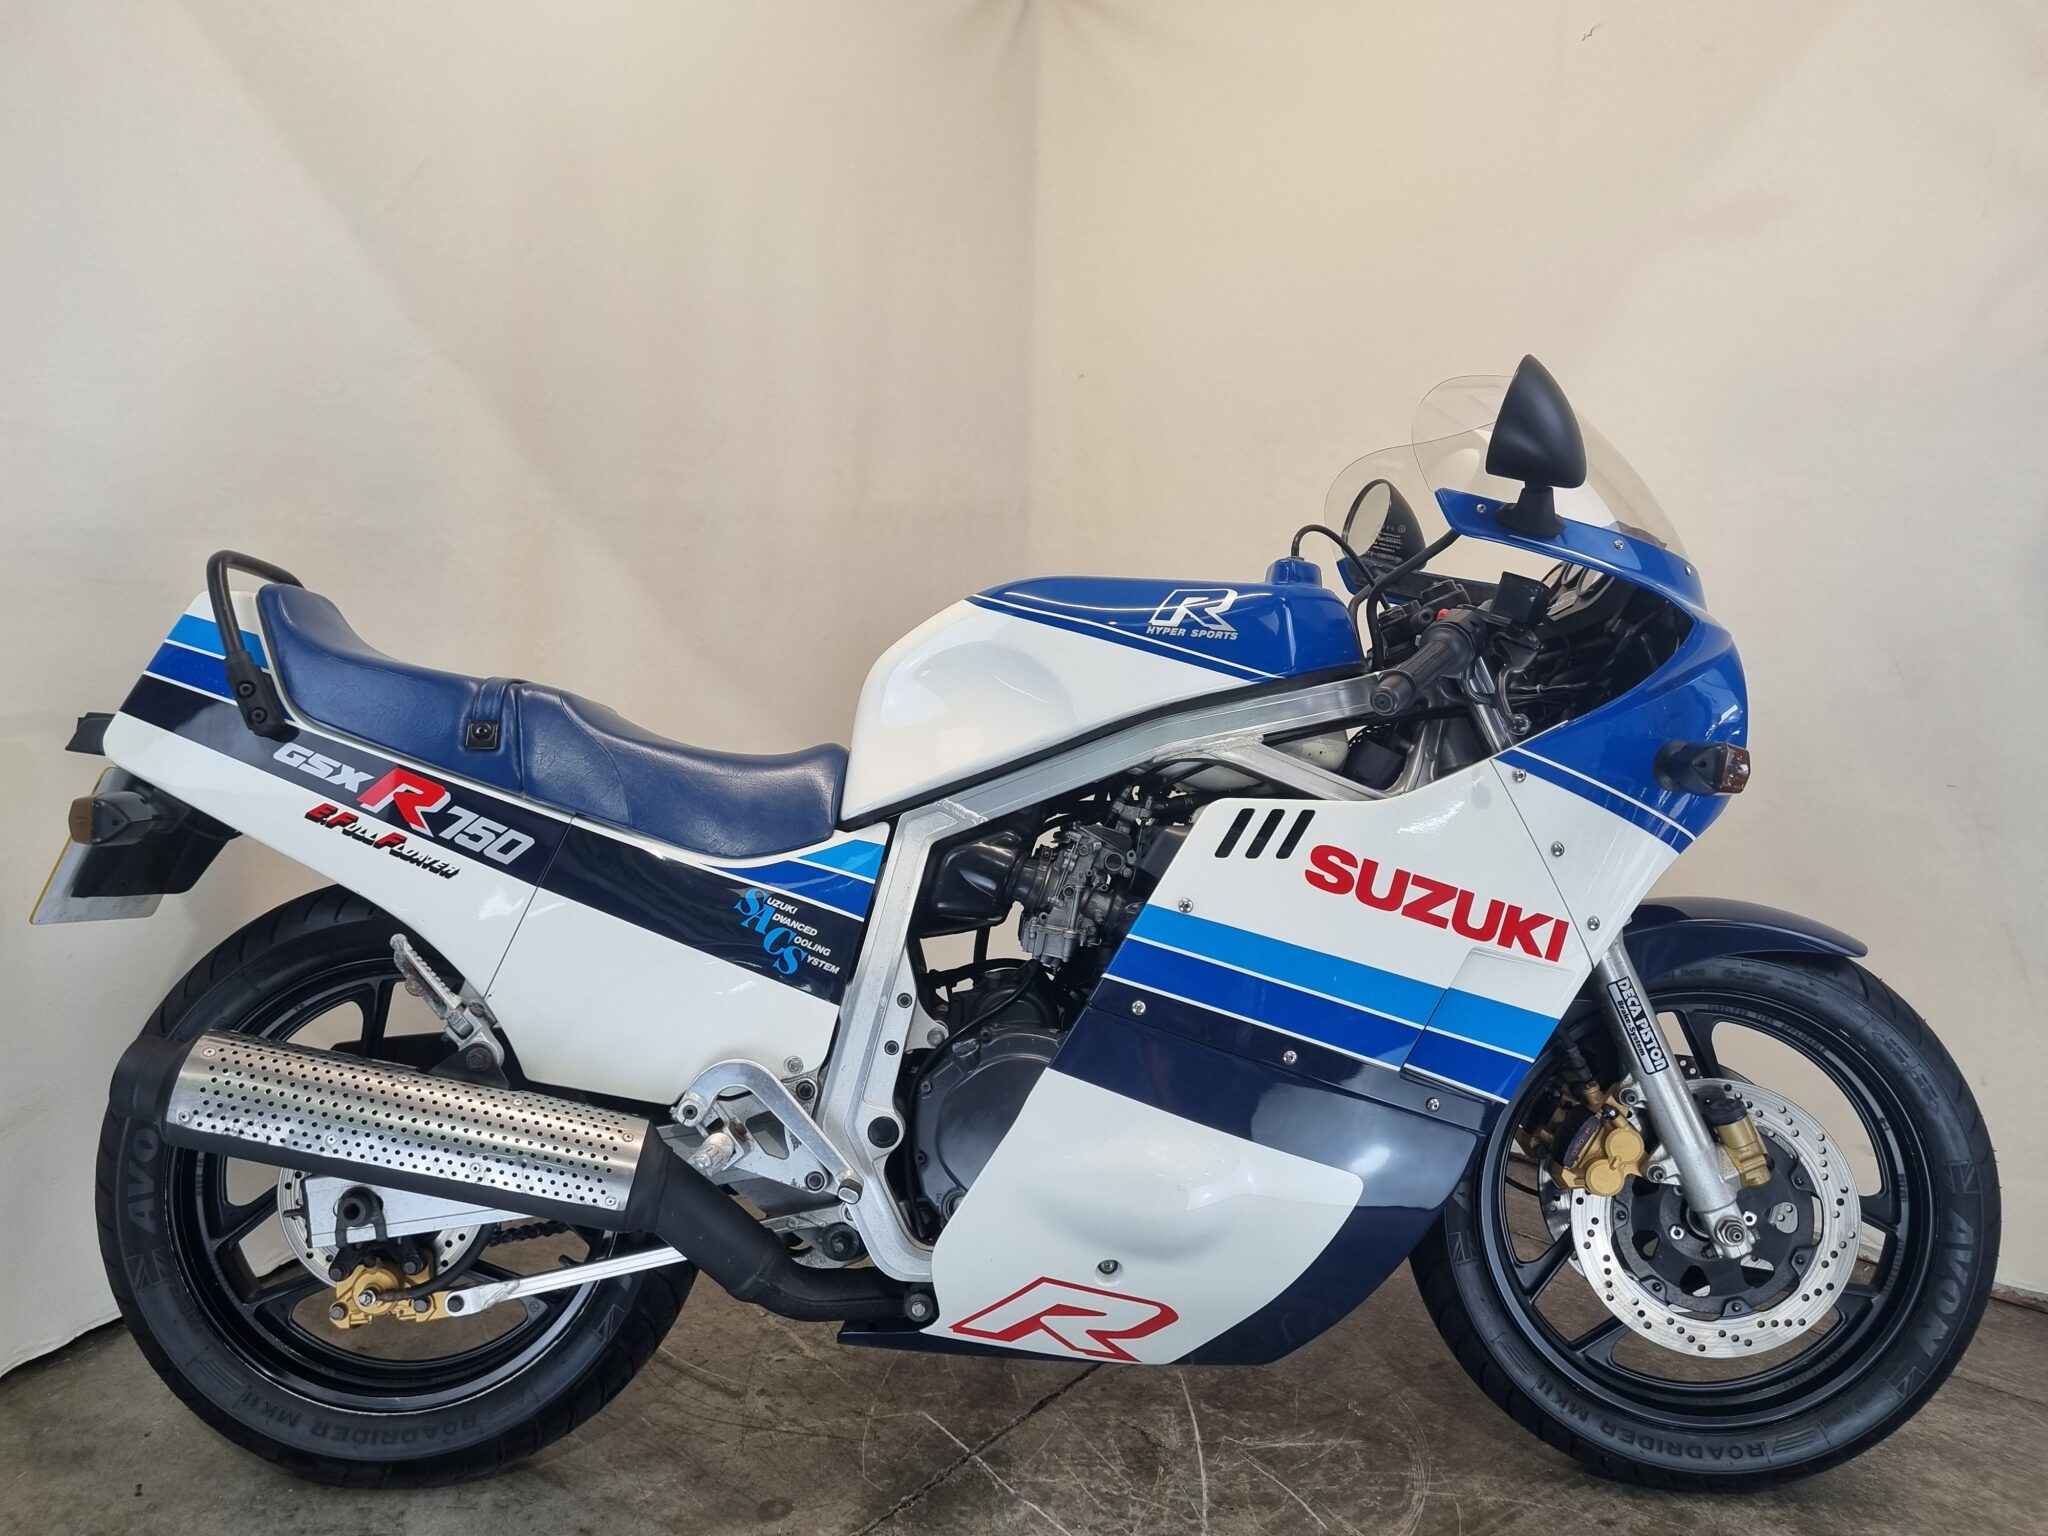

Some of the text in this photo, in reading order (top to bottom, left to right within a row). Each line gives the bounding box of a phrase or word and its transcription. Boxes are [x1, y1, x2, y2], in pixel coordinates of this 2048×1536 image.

[1148, 588, 1238, 631] R
[1146, 625, 1239, 640] HYPER SPORTS
[273, 742, 535, 865] GSX R 750
[734, 887, 798, 916] SUZUKI
[741, 904, 818, 936] ADVANCED
[1304, 844, 1570, 963] SUZUKI
[764, 927, 831, 957] COOLING
[772, 945, 840, 975] SYSTEM
[1617, 978, 1643, 1019] DECA
[127, 1127, 160, 1235] AVO
[1914, 1207, 1975, 1359] AVON
[947, 1276, 1179, 1363] R
[309, 1411, 479, 1446] ROADRIDER
[1600, 1420, 1765, 1460] ROADRIDER
